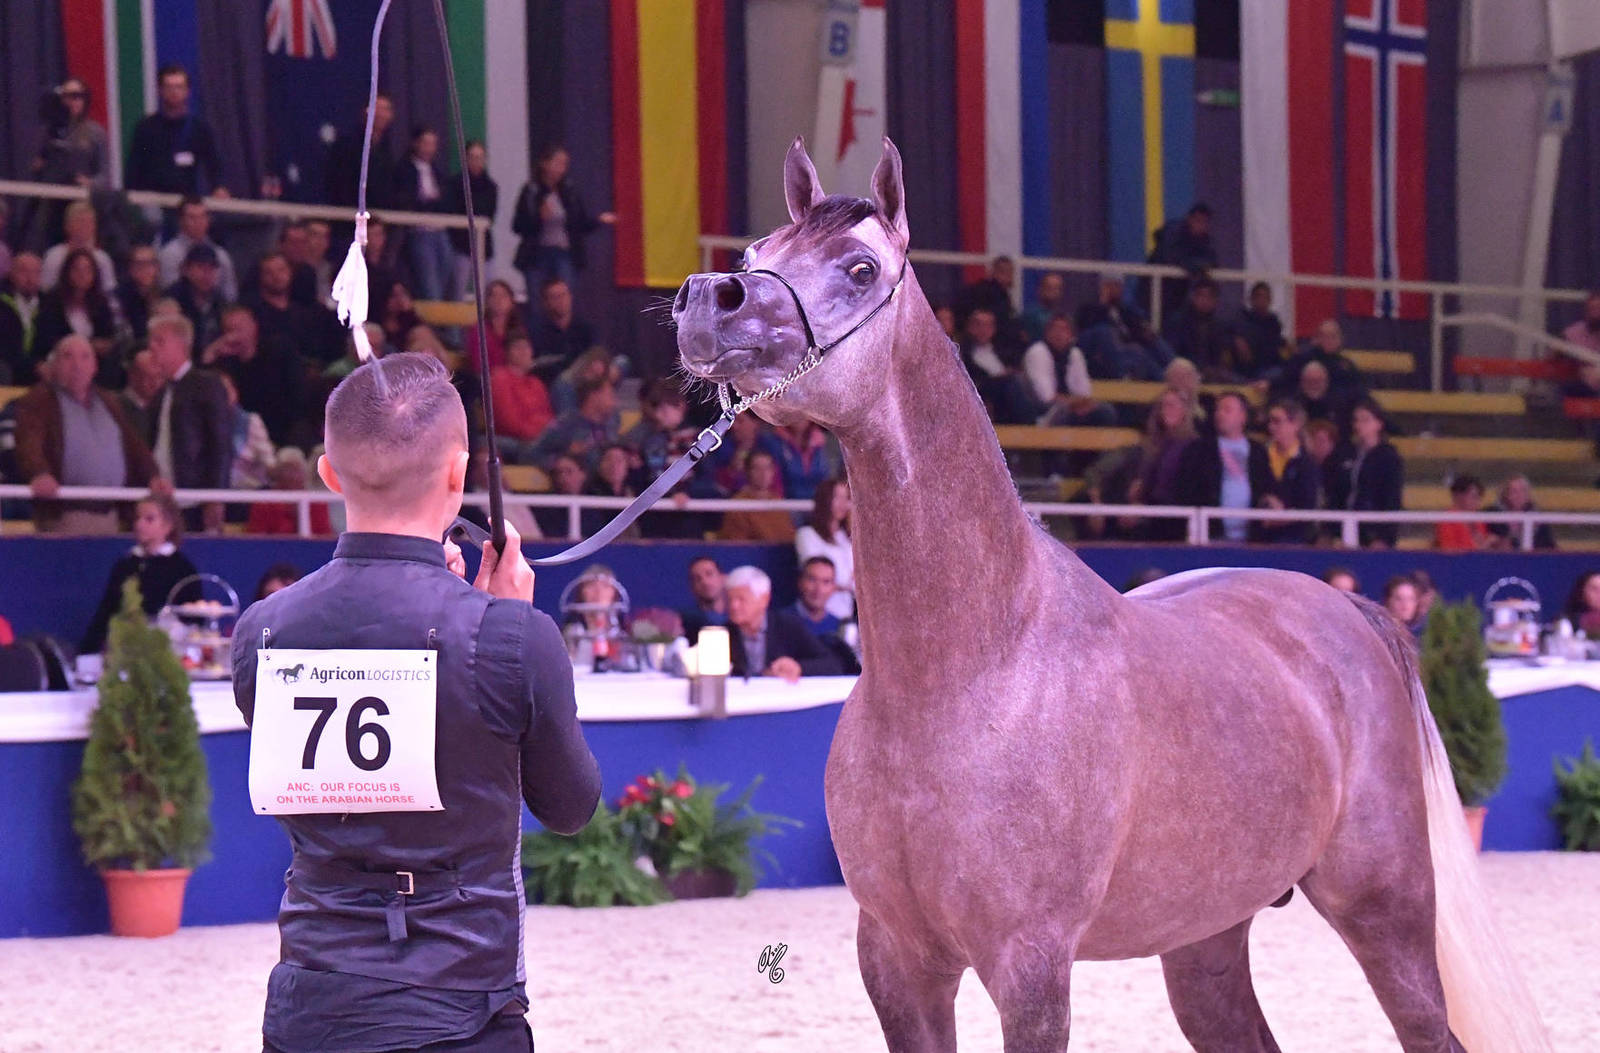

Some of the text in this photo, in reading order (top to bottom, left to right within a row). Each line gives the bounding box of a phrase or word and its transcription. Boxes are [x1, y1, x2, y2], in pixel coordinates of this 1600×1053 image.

[830, 21, 850, 56] B
[294, 696, 391, 771] 76
[287, 783, 401, 792] ANC: OUR FOCUS IS
[276, 795, 415, 804] ON THE ARABIAN HORSE
